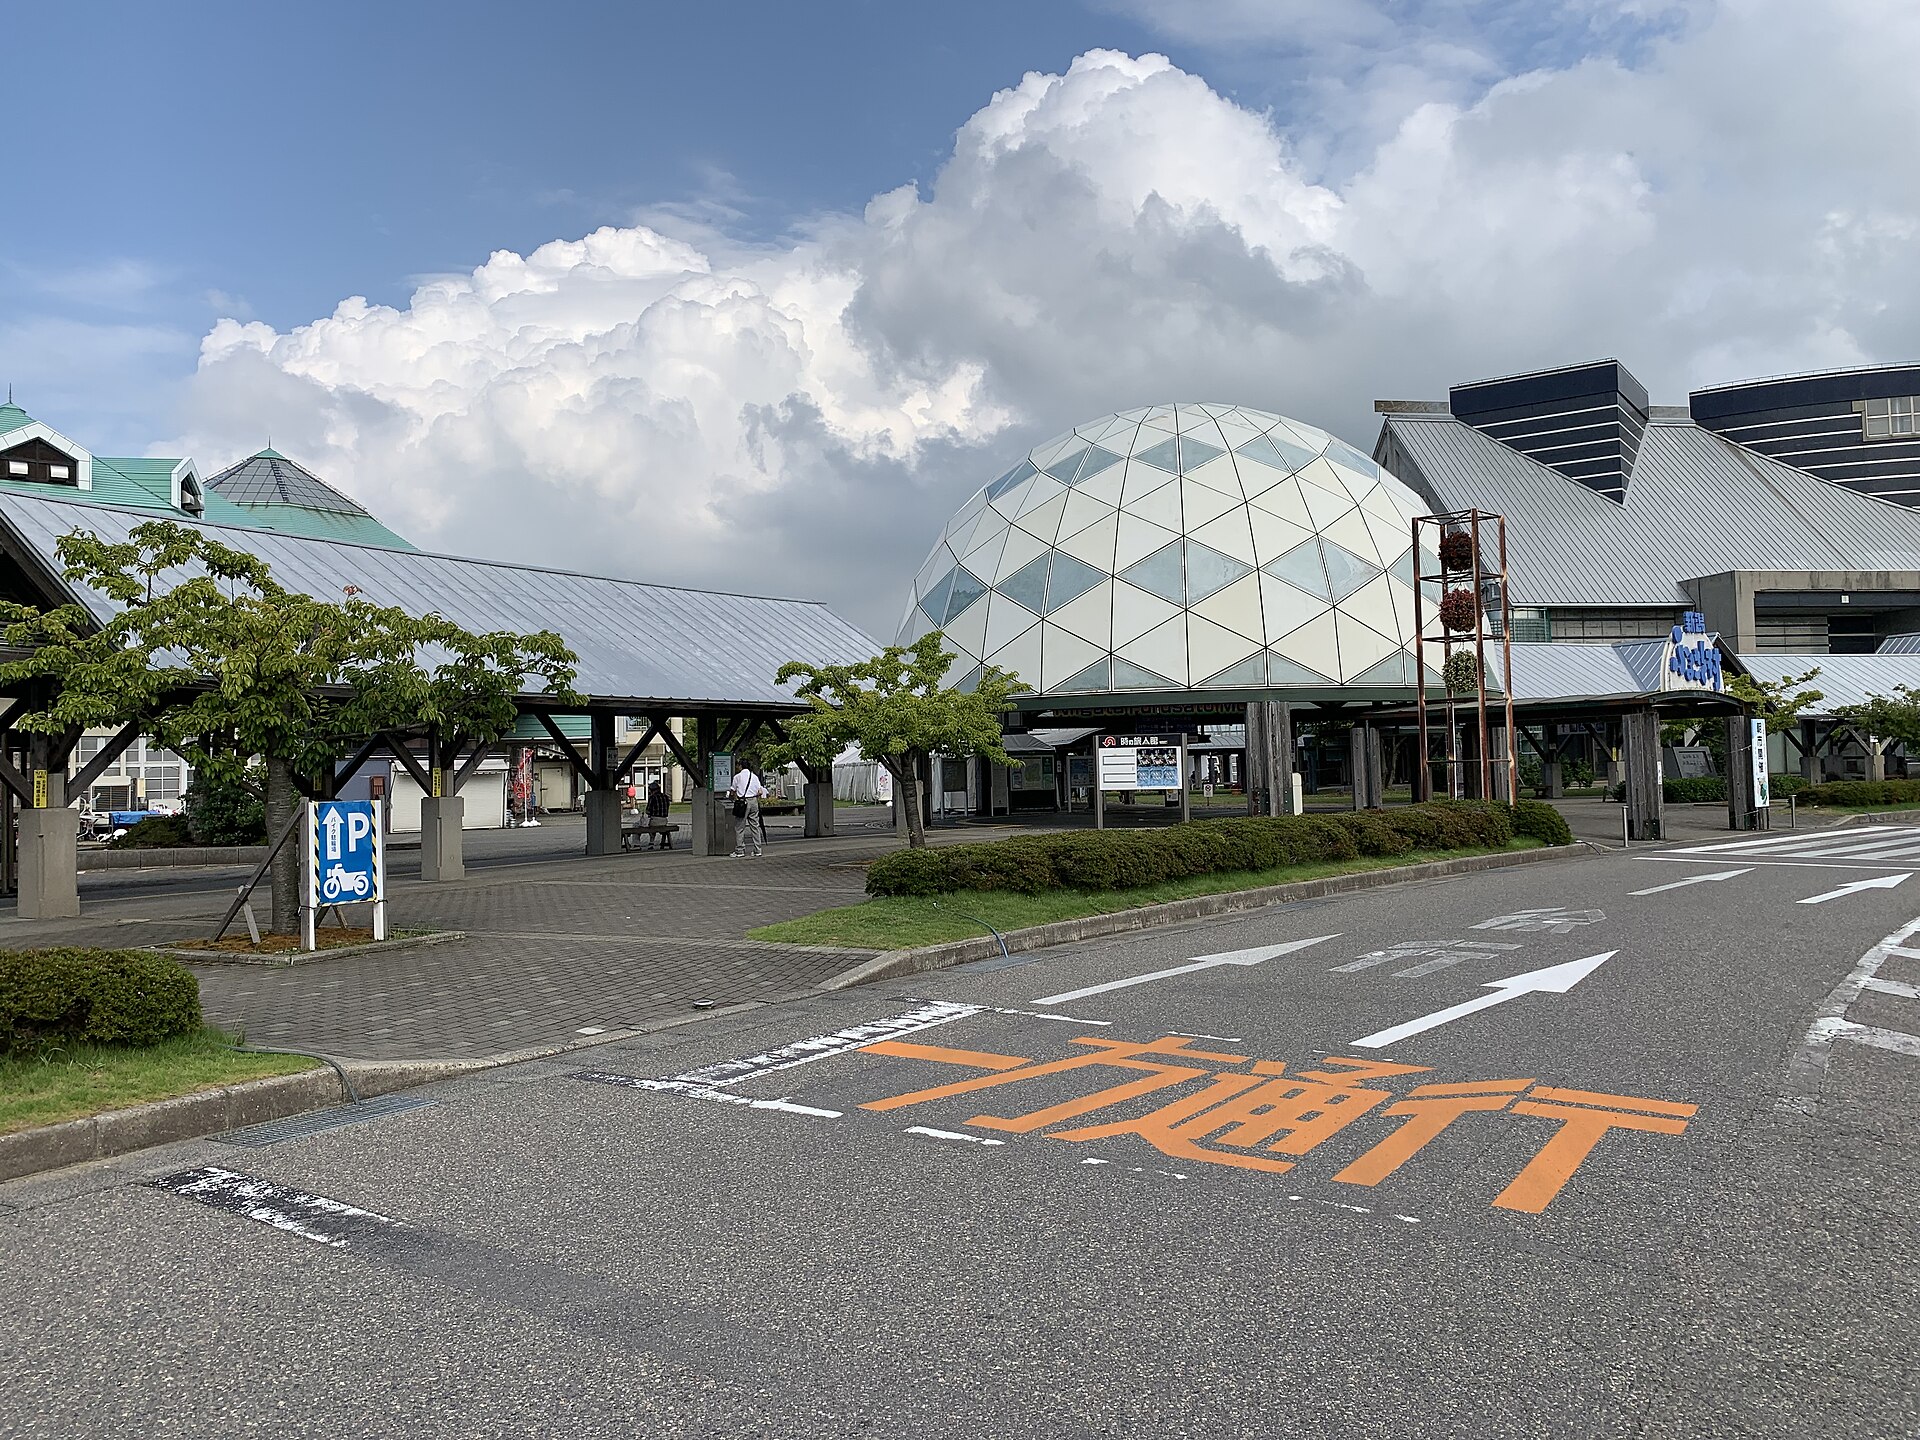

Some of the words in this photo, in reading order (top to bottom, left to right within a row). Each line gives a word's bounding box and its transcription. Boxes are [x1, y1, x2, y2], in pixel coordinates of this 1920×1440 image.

[347, 812, 370, 853] P
[855, 1036, 1700, 1214] 一方通行
